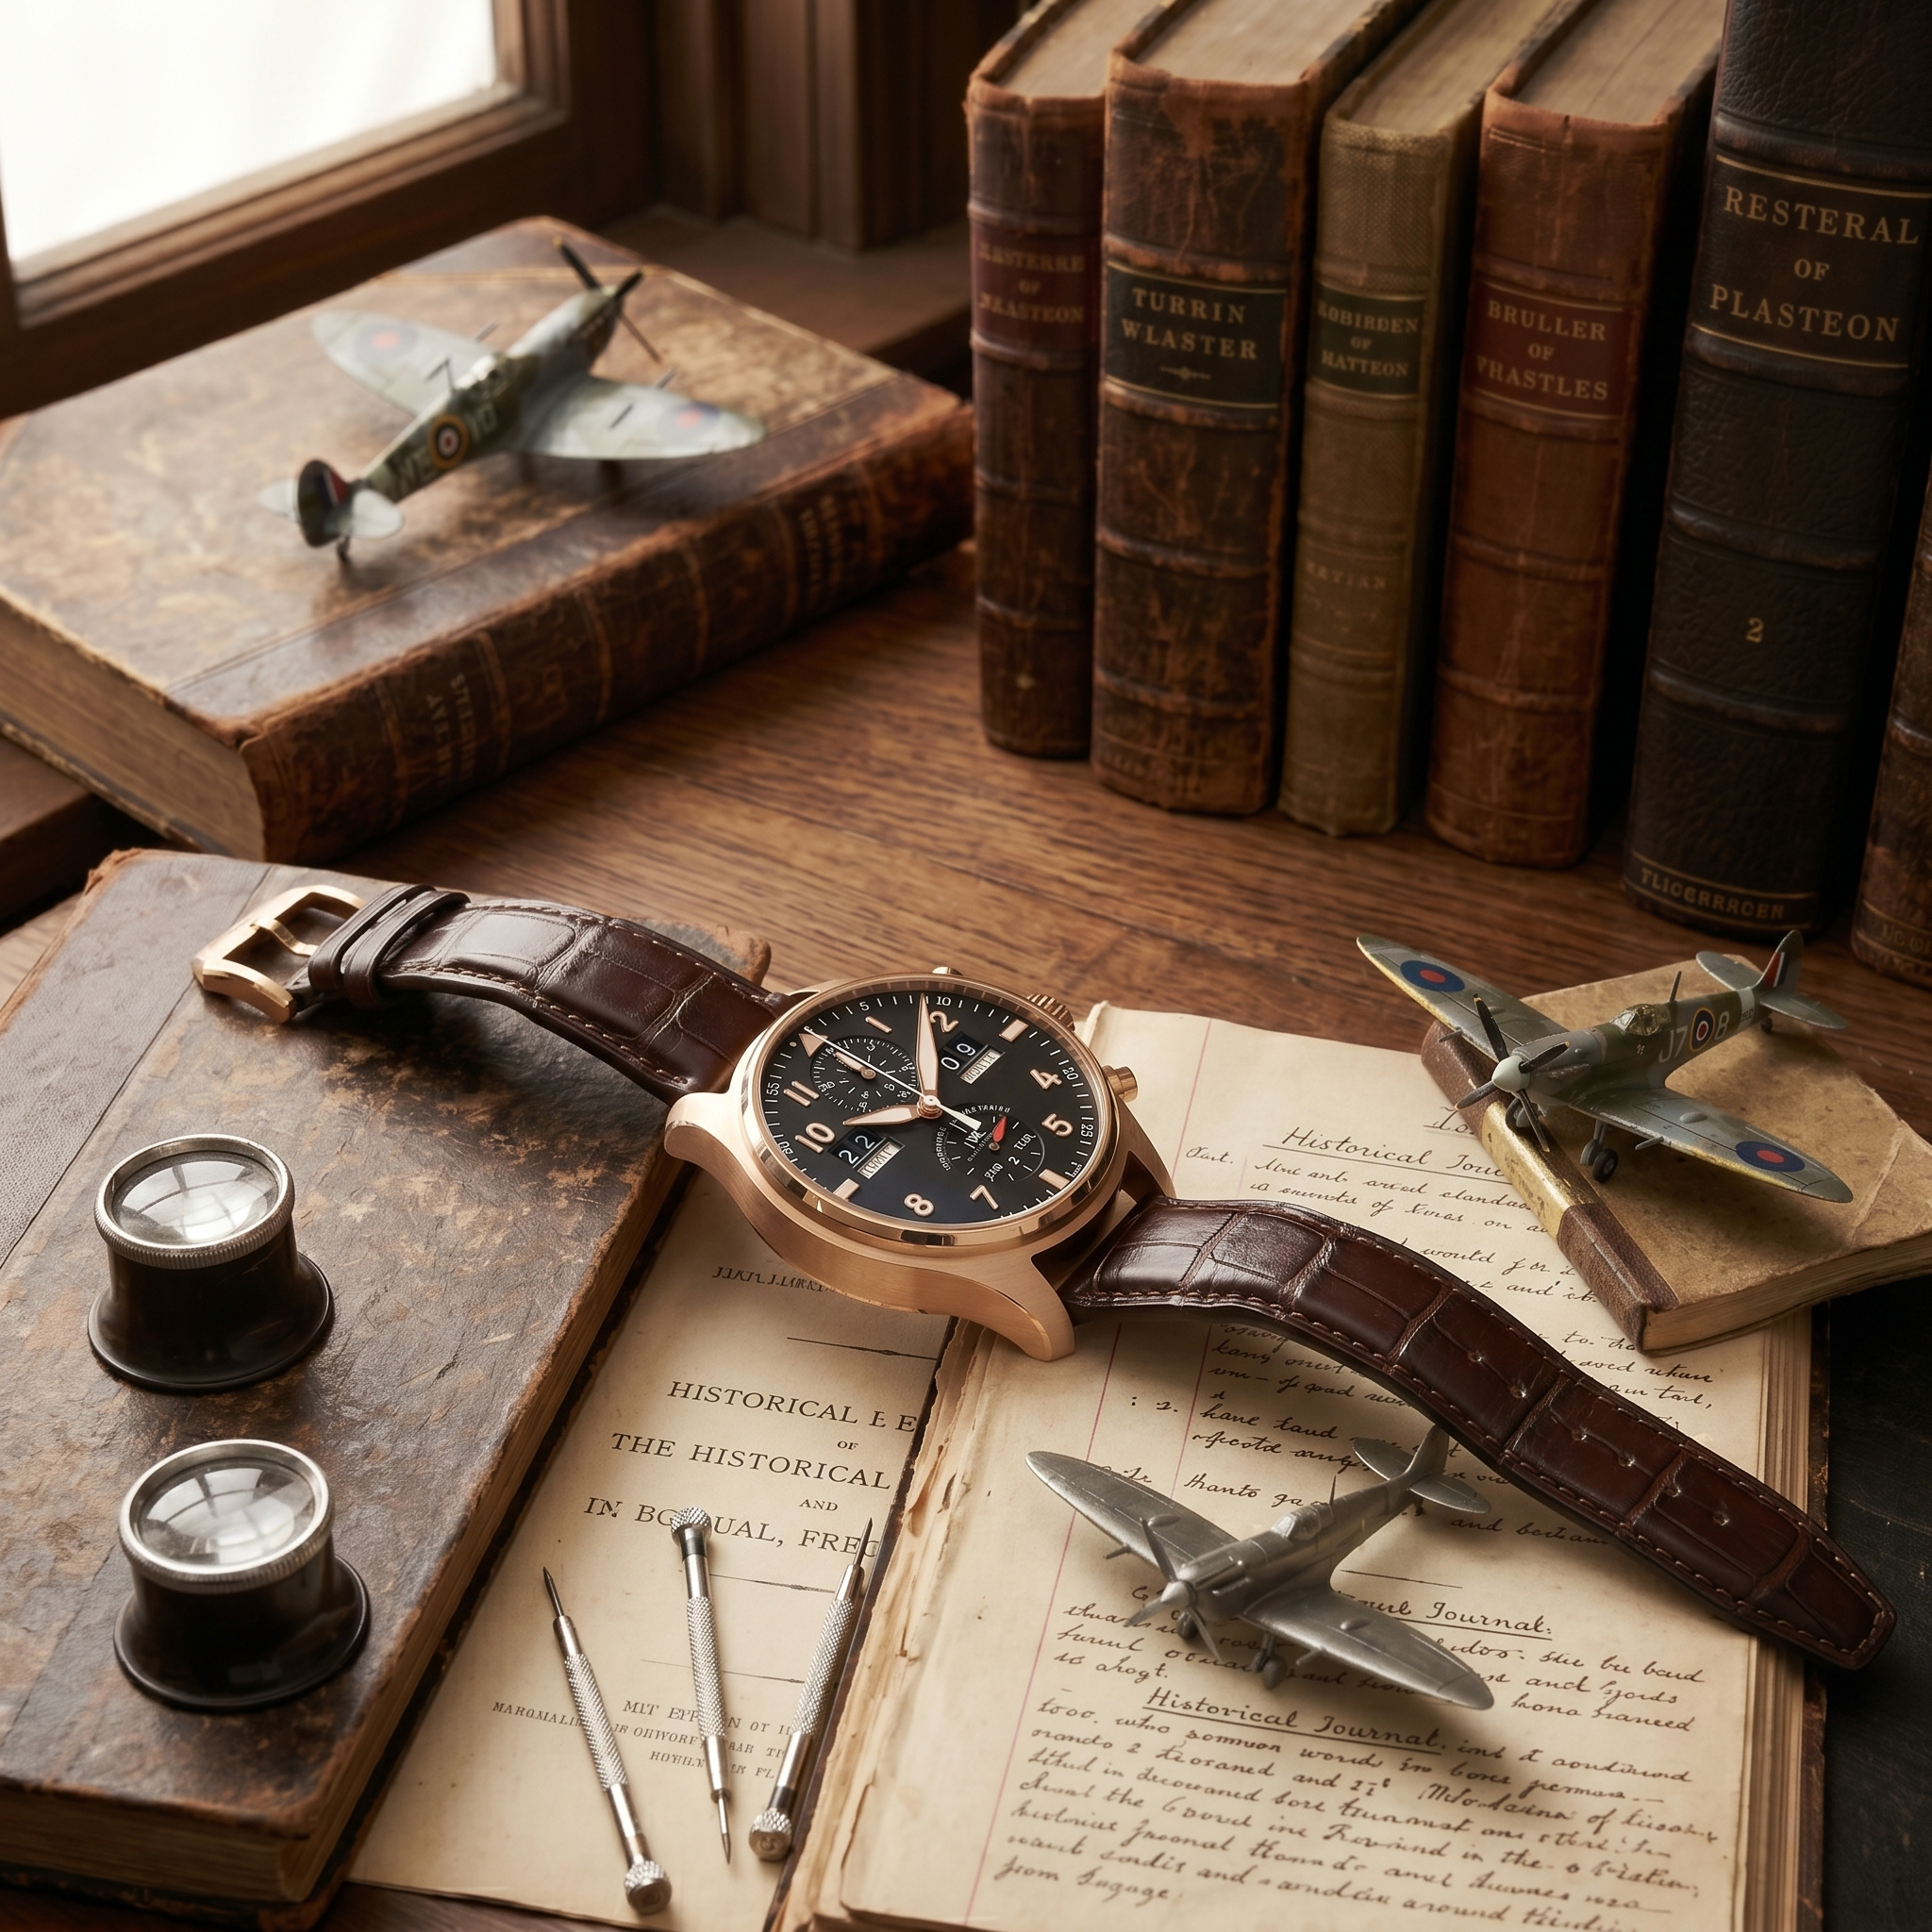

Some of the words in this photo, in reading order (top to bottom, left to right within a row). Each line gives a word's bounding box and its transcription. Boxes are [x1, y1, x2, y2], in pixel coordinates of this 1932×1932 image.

[1723, 185, 1920, 245] RESTERAL
[1793, 258, 1830, 281] OF
[1132, 289, 1246, 325] TURRIN
[1709, 283, 1900, 342] PLASTEON
[1487, 299, 1607, 341] BRULLER
[1122, 319, 1257, 359] WLASTER
[1527, 342, 1556, 361] OF
[1745, 617, 1764, 643] 2
[858, 1001, 870, 1011] 5
[936, 996, 952, 1007] 10
[929, 1010, 959, 1033] 2
[1029, 1068, 1062, 1090] 4
[794, 1122, 836, 1154] 10
[1041, 1113, 1074, 1138] 5
[1281, 1126, 1433, 1165] Historical
[904, 1193, 935, 1217] 8
[969, 1184, 999, 1210] 7
[1420, 1248, 1496, 1264] would
[667, 1381, 858, 1425] HISTORICAL
[837, 1441, 859, 1451] OF
[611, 1432, 676, 1457] THE
[688, 1443, 892, 1491] HISTORICAL
[583, 1496, 624, 1519] IN
[799, 1498, 840, 1511] AND
[1146, 1686, 1298, 1728] Historical
[1103, 1788, 1144, 1808] the
